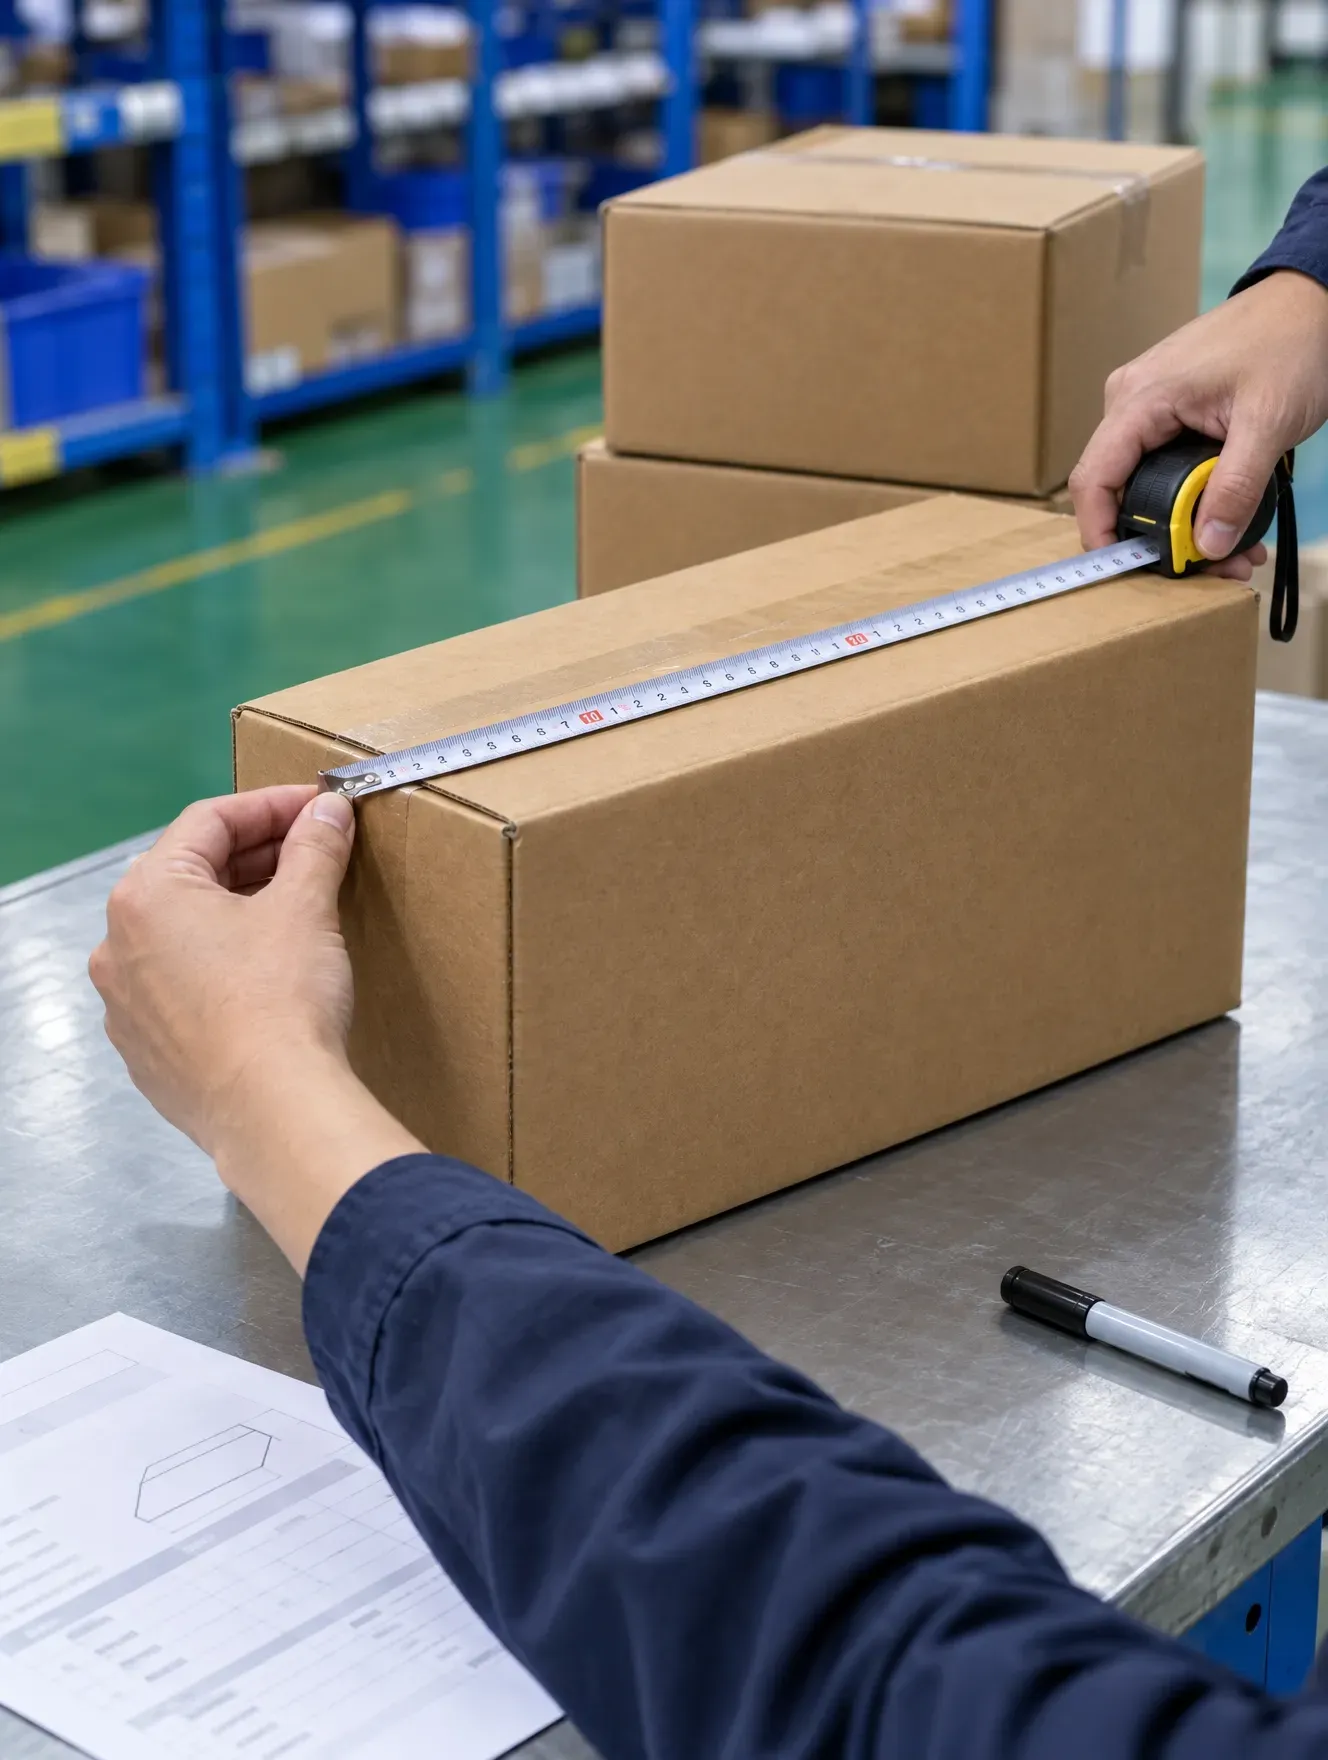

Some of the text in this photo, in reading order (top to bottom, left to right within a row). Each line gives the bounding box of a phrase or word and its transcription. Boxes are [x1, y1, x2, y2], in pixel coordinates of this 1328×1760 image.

[512, 735, 522, 743] 6
[560, 721, 570, 729] 7
[610, 707, 618, 715] 1
[634, 700, 644, 708] 2
[657, 693, 667, 701] 2
[894, 624, 903, 632] 2
[914, 618, 924, 626] 2
